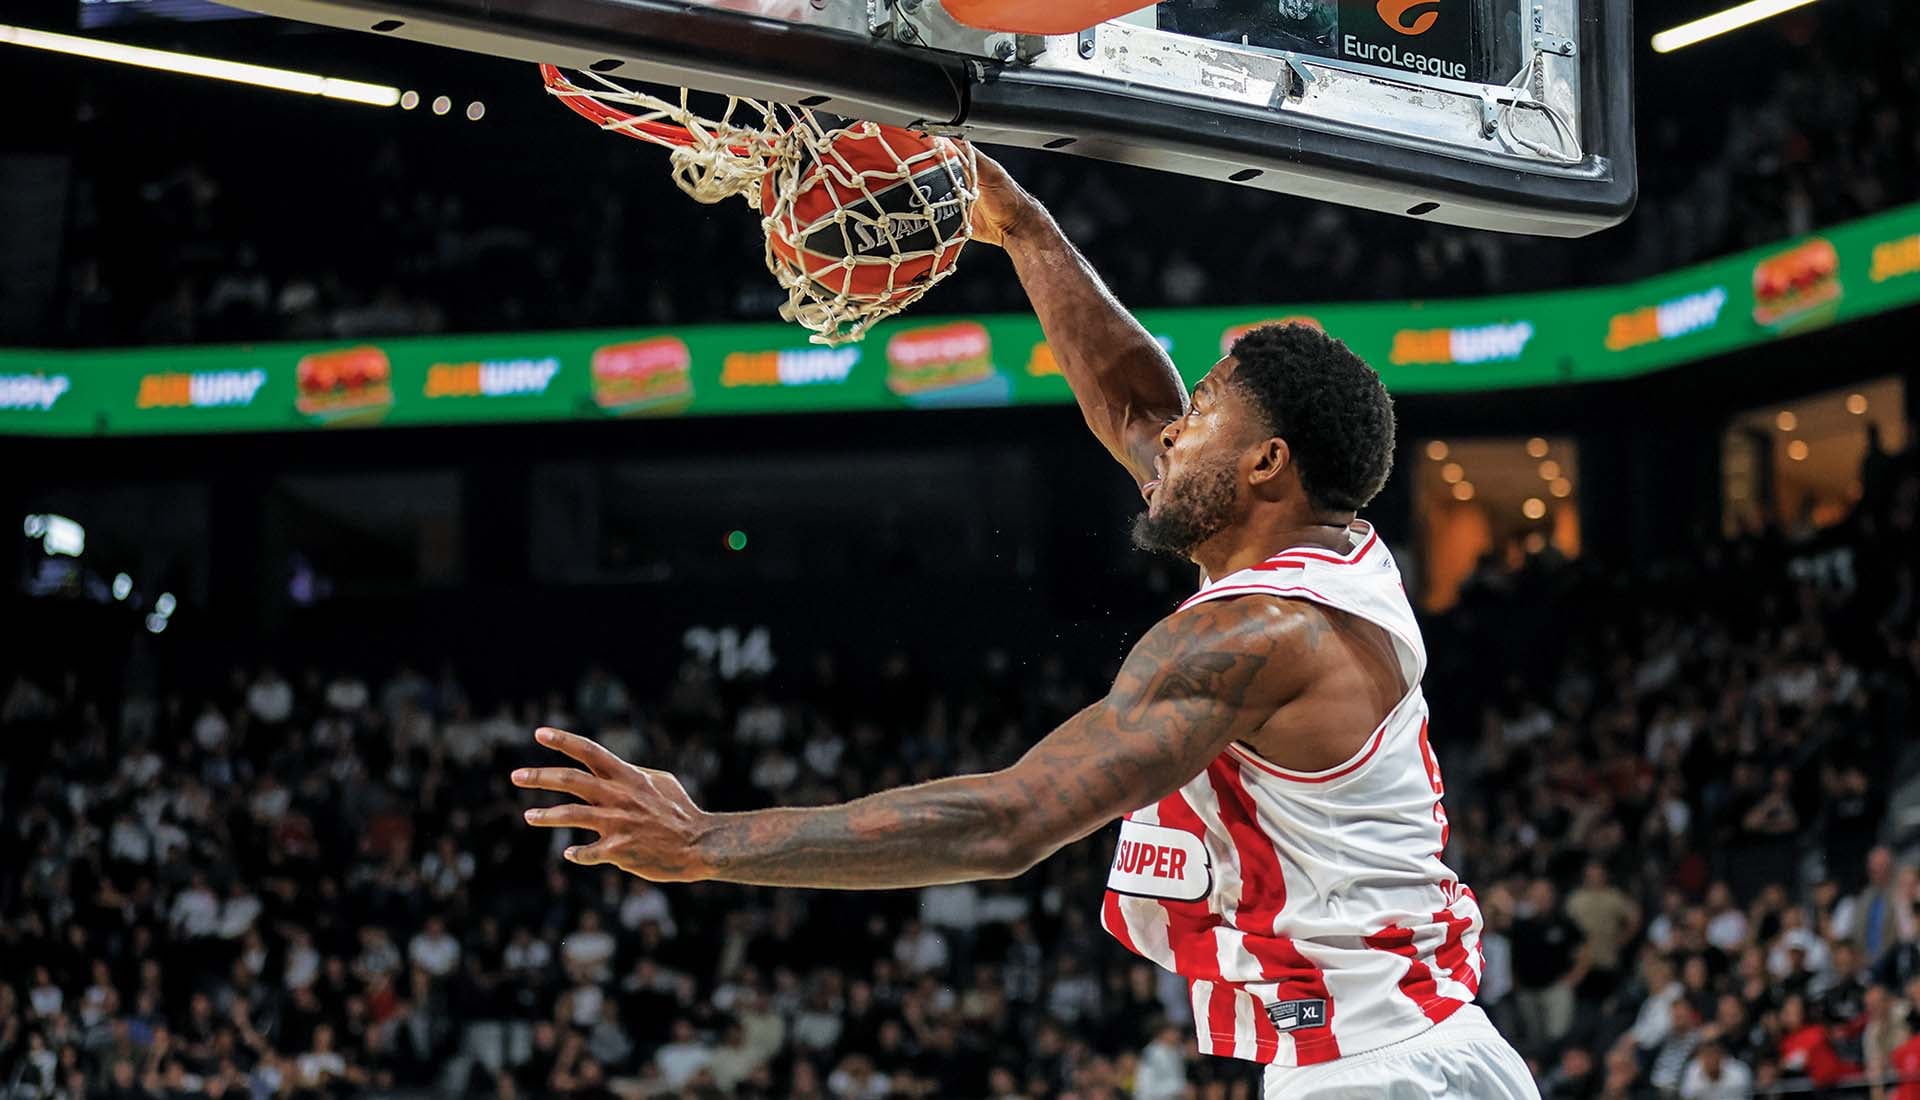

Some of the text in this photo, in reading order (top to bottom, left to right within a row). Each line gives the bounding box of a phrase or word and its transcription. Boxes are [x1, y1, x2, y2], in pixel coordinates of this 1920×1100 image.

[1534, 16, 1542, 33] M2
[1344, 34, 1466, 79] EuroLeague
[1117, 840, 1187, 880] SUPER
[1303, 1006, 1319, 1019] XL
